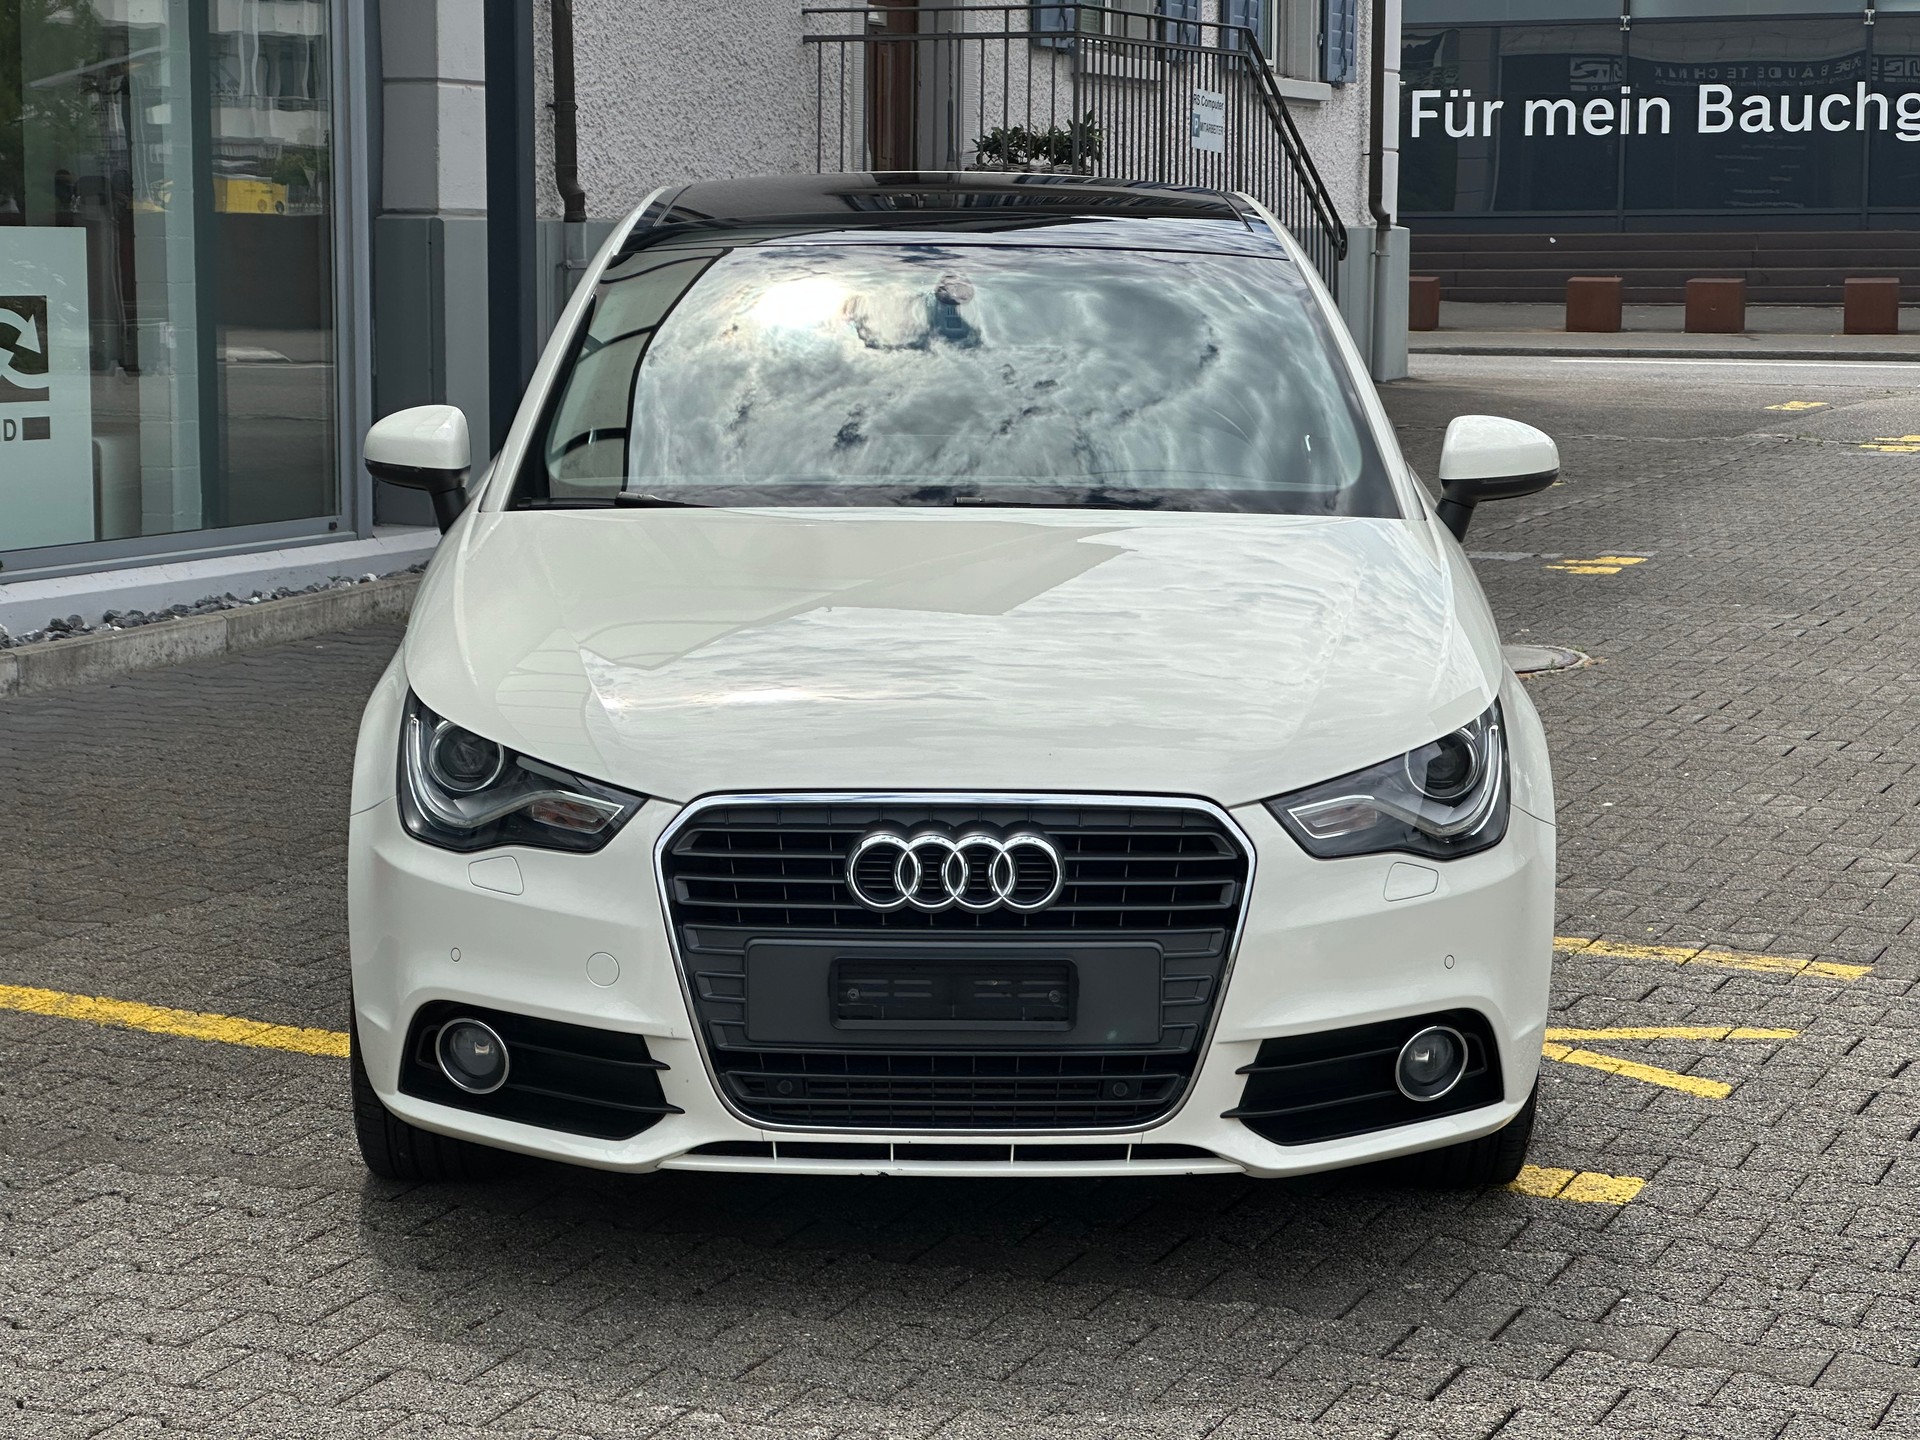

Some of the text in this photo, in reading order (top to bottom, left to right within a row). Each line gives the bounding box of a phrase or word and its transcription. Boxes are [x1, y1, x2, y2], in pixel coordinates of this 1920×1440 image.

[1201, 95, 1224, 111] Computer
[1411, 81, 1920, 142] Für mein Bauchg
